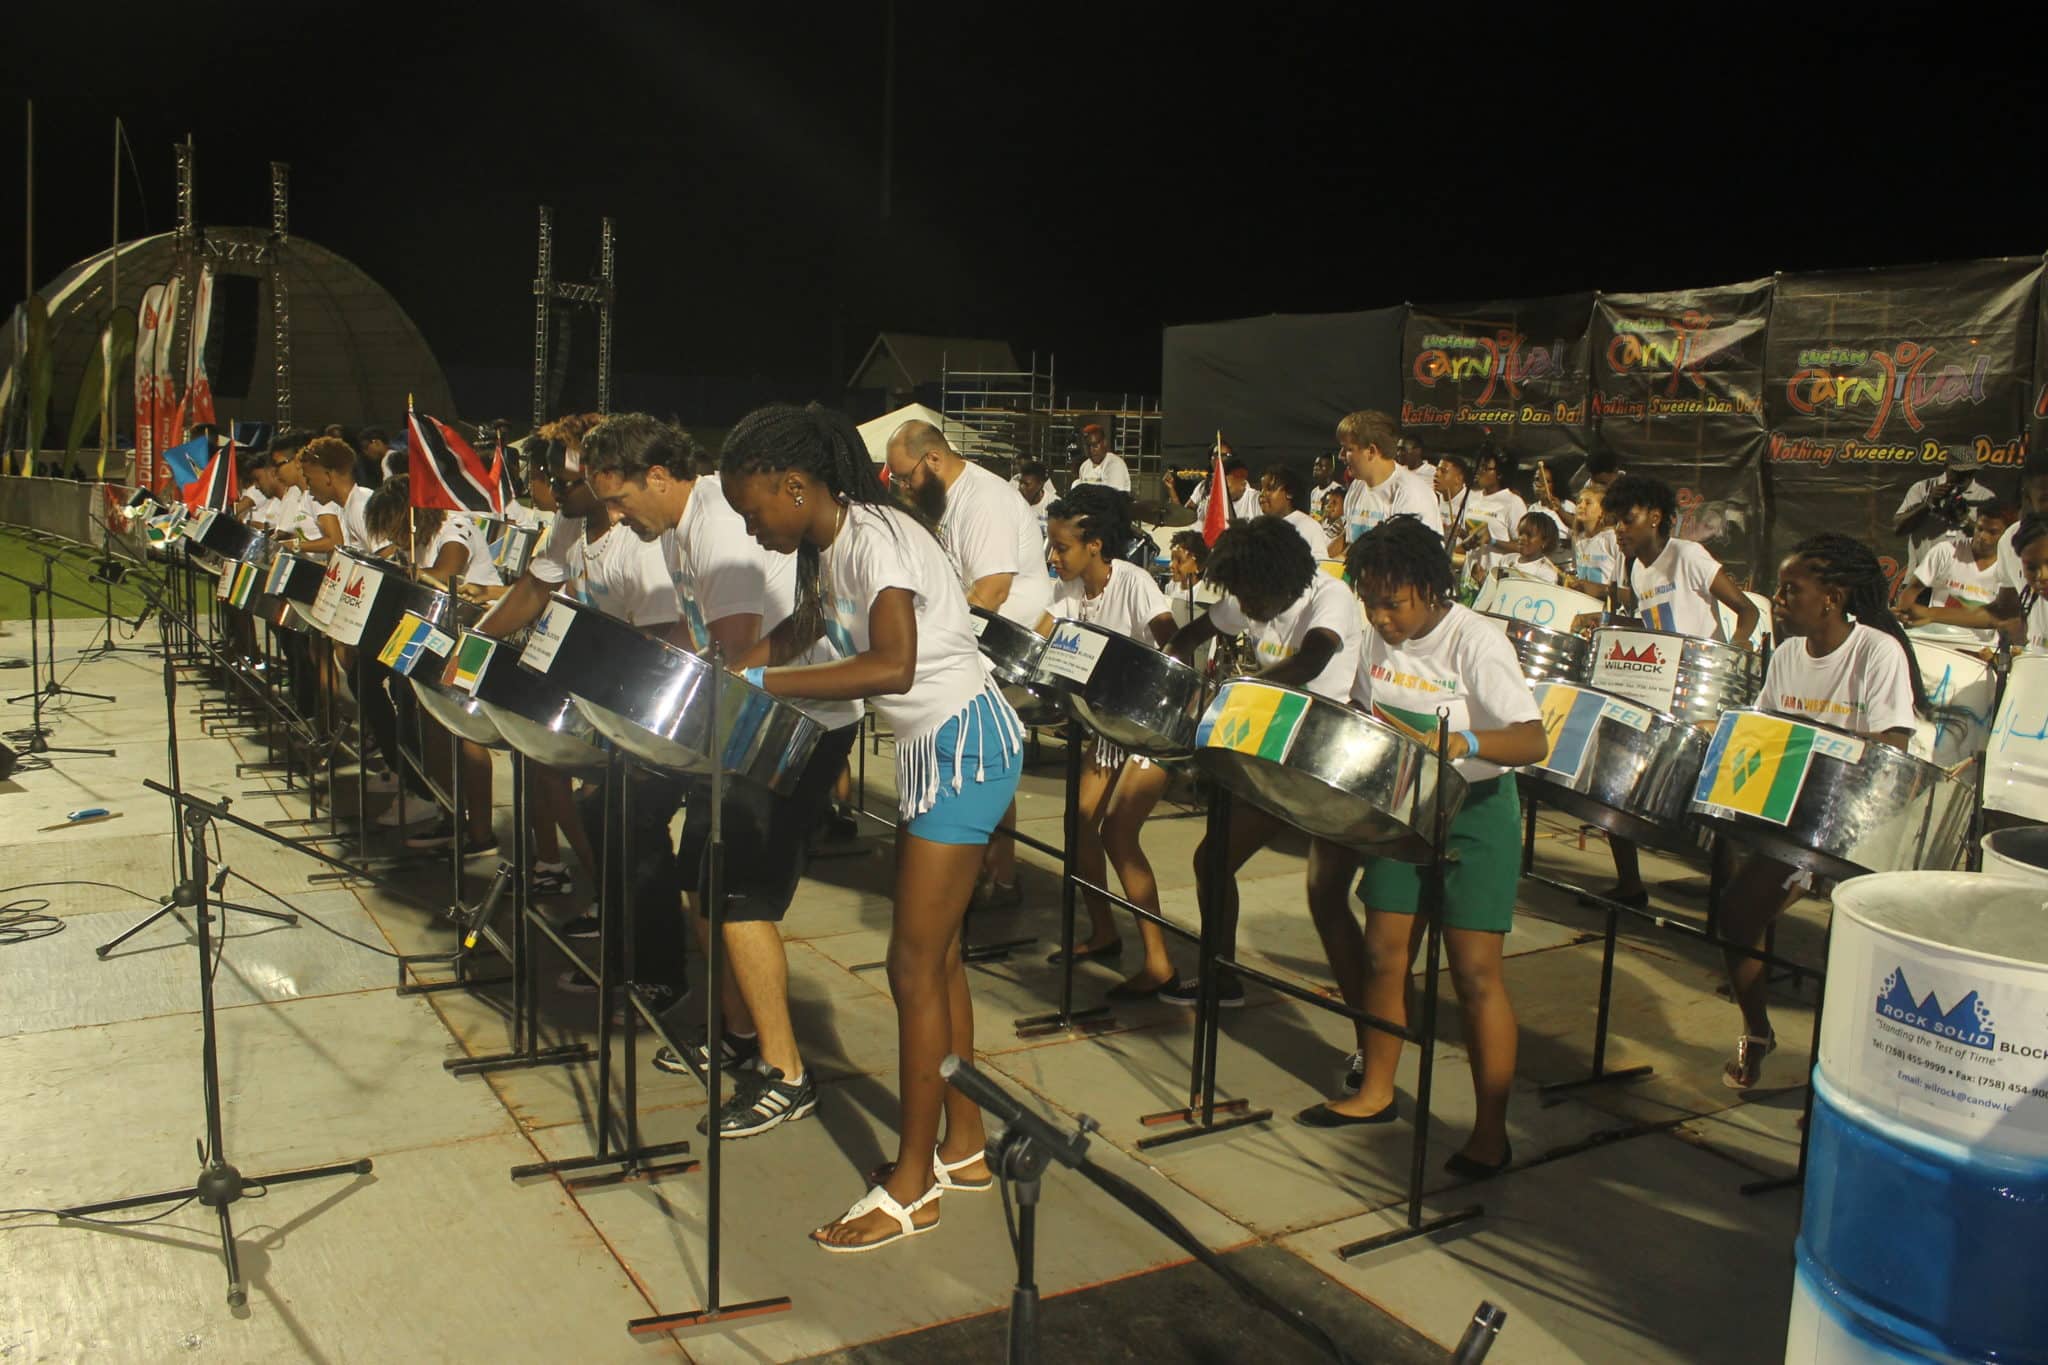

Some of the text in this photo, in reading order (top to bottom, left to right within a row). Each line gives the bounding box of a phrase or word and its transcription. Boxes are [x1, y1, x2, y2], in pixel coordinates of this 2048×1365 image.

[1401, 401, 1450, 428] Nothing
[1457, 404, 1517, 424] Sweeter
[1520, 404, 1551, 423] Dan
[1649, 396, 1704, 416] Sweeter
[1706, 396, 1733, 413] Dan
[1769, 431, 1834, 466] Nothing
[1839, 439, 1917, 464] Sweeter
[1920, 438, 1948, 463] Da
[1605, 661, 1662, 674] WILROCK
[1883, 1004, 1990, 1046] ROCK SOLID
[1916, 1033, 1932, 1048] the
[1934, 1039, 1953, 1056] Test
[1954, 1048, 1967, 1061] of
[1897, 1070, 1923, 1088] Email:
[1978, 1077, 2006, 1092] (758)
